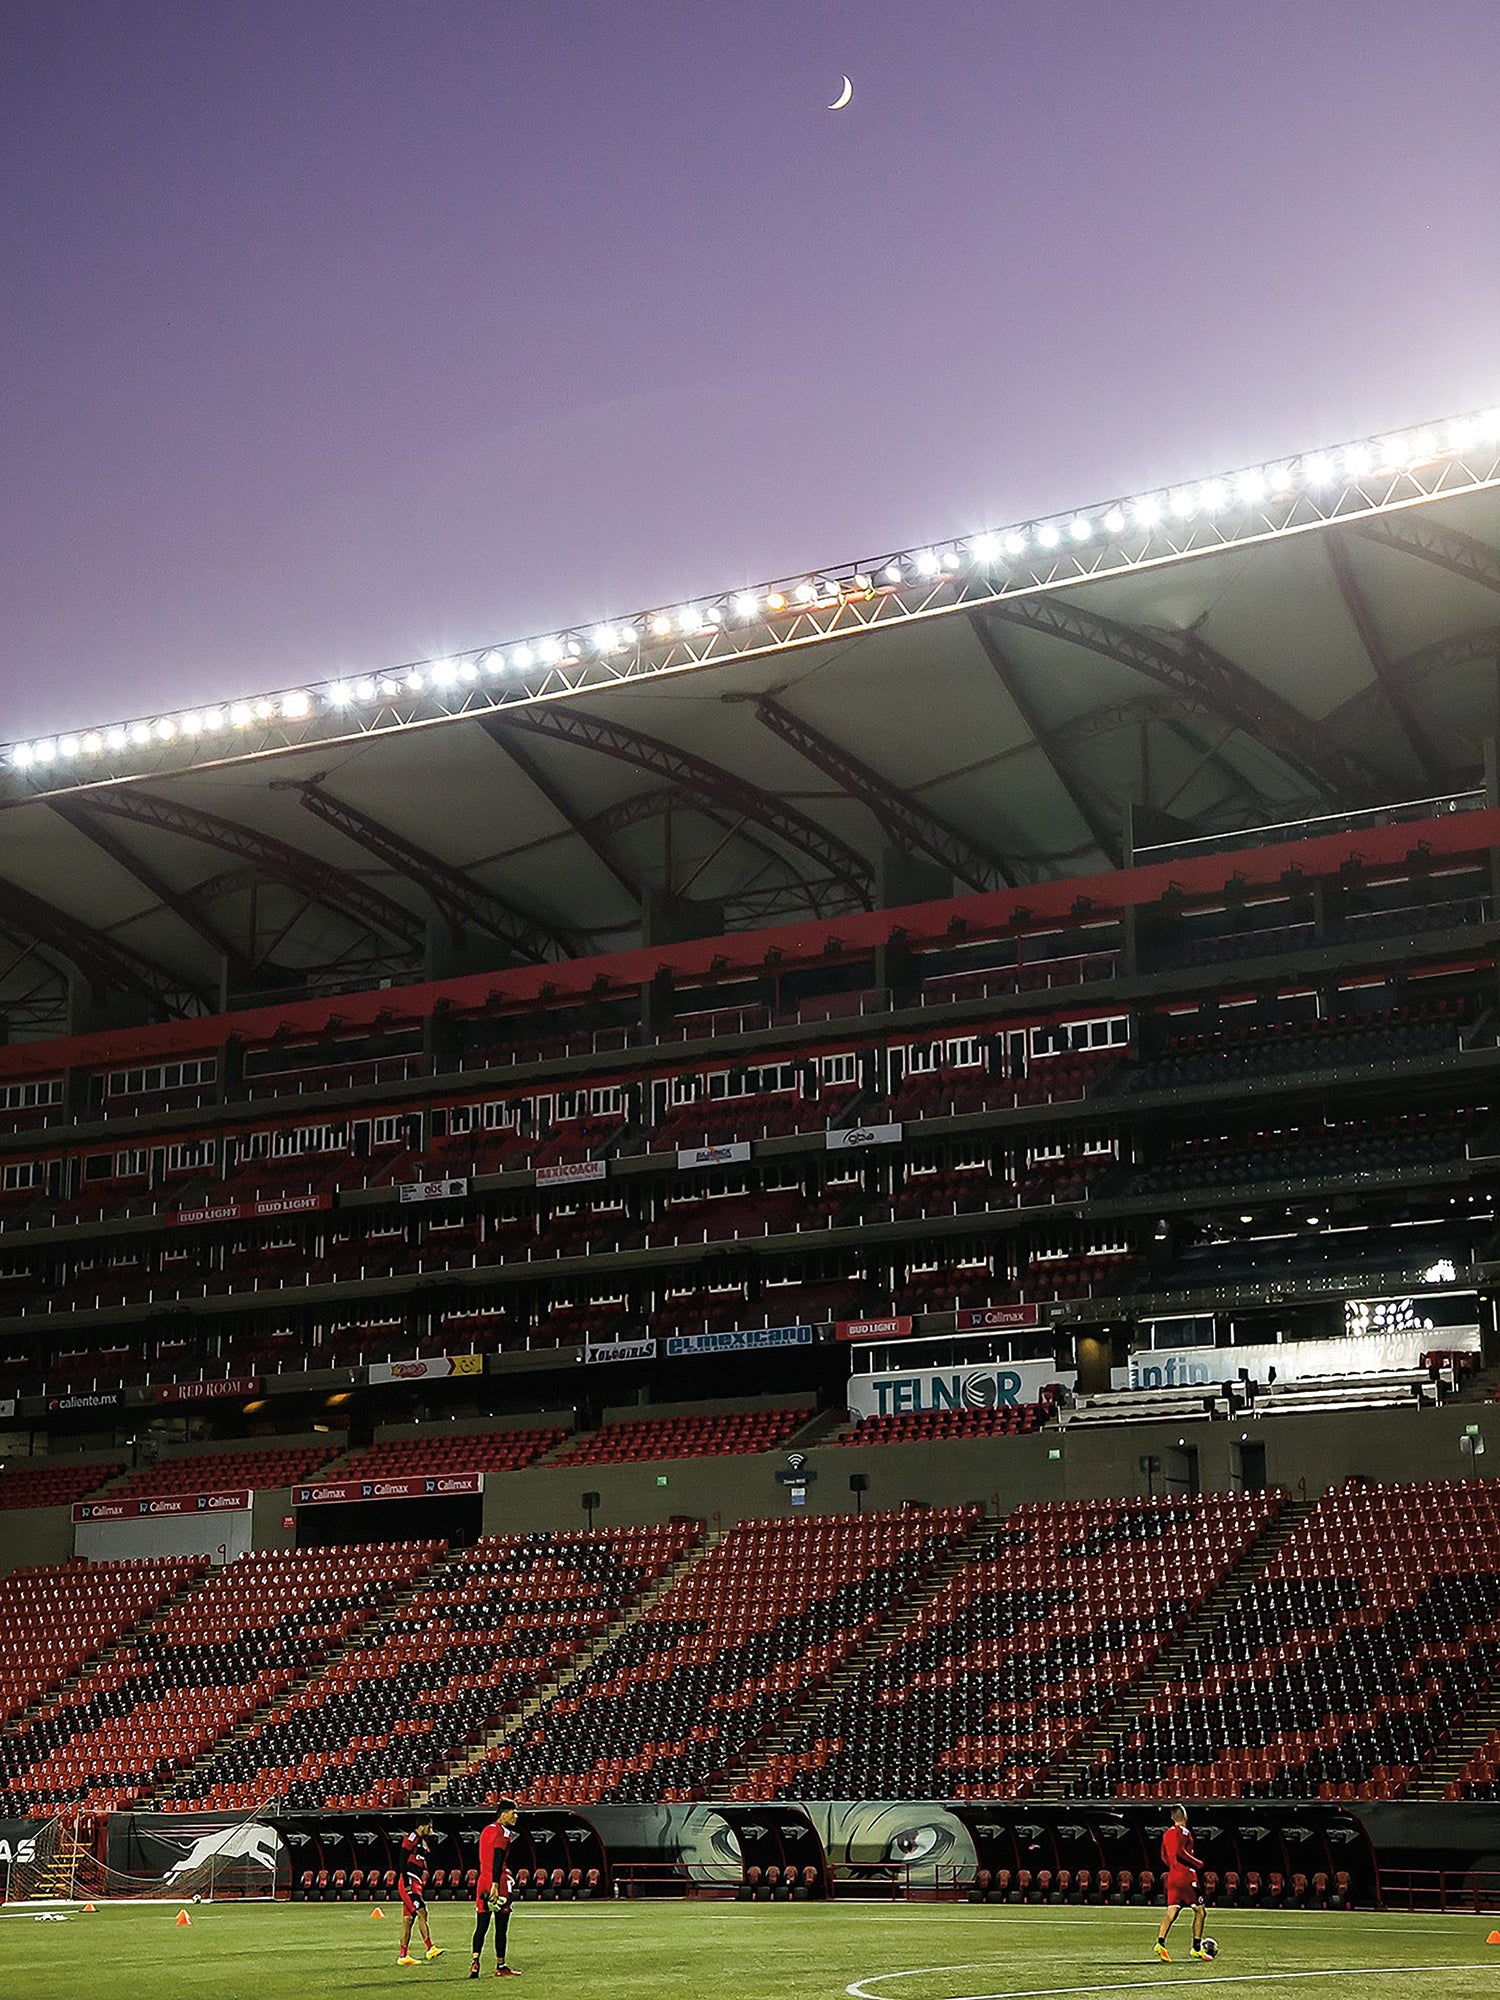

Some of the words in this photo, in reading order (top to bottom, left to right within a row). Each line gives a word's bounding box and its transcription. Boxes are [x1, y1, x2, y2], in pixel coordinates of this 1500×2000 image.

[538, 1163, 598, 1178] MEXICOACH
[258, 1202, 281, 1213] BUD
[283, 1198, 316, 1210] LIGHT
[180, 1212, 203, 1223] BUD
[205, 1207, 238, 1220] LIGHT
[985, 1311, 1024, 1325] Calimax
[850, 1324, 868, 1335] BUD
[869, 1322, 896, 1333] LIGHT
[179, 1383, 201, 1399] RED
[206, 1380, 241, 1397] ROOM
[873, 1370, 1022, 1417] TELNOR
[60, 1394, 117, 1409] caliente.mx
[312, 1489, 346, 1500] Calimax
[374, 1484, 408, 1495] Calimax
[437, 1480, 472, 1491] Calimax
[92, 1506, 123, 1516] Calimax
[150, 1501, 182, 1512] Calimax
[208, 1497, 240, 1507] Calimax
